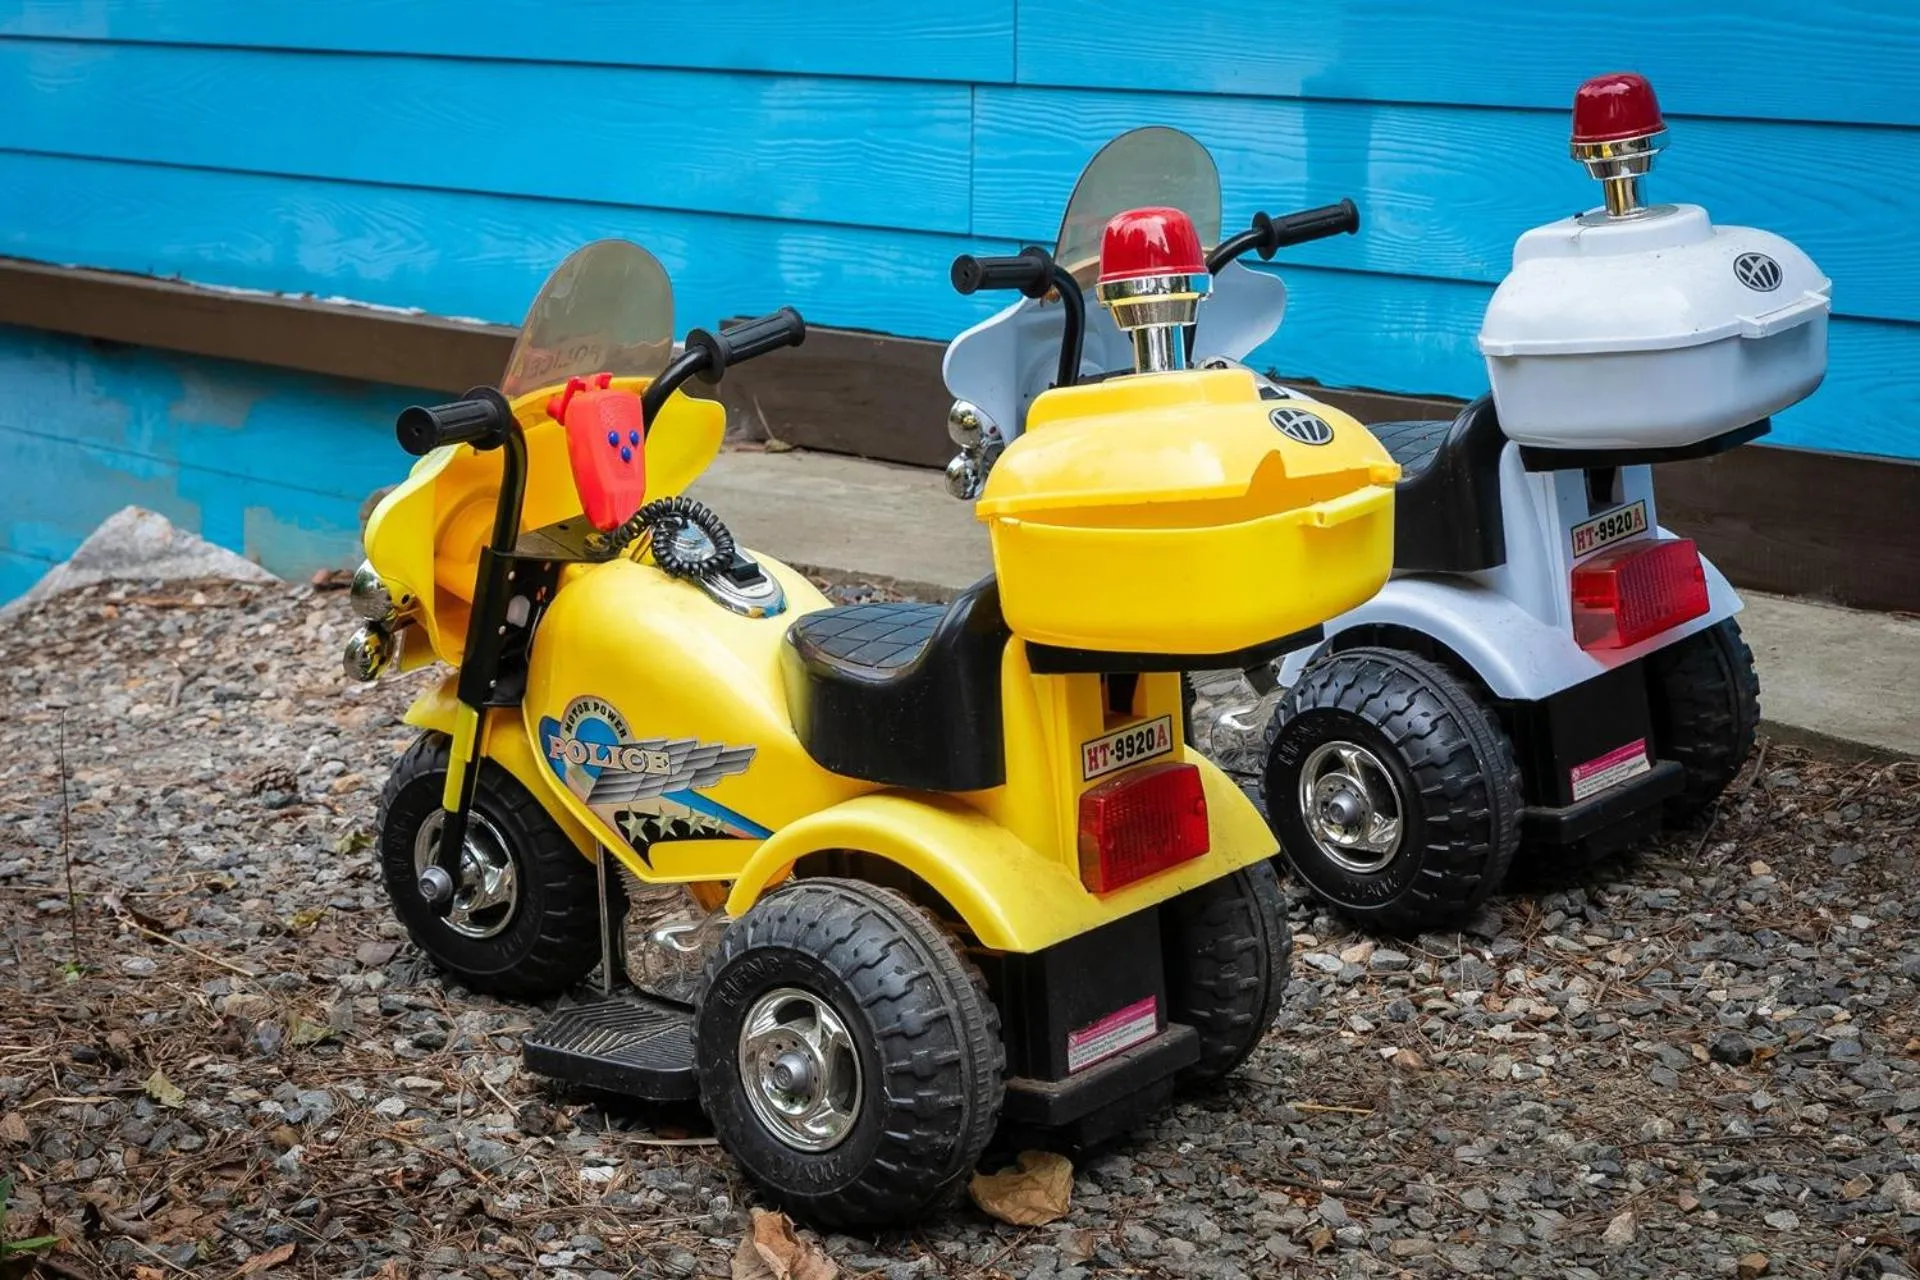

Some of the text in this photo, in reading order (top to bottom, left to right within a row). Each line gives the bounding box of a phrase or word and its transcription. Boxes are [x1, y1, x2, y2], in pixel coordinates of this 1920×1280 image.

[565, 701, 627, 738] MOTOR POWER
[548, 735, 671, 774] POLICE
